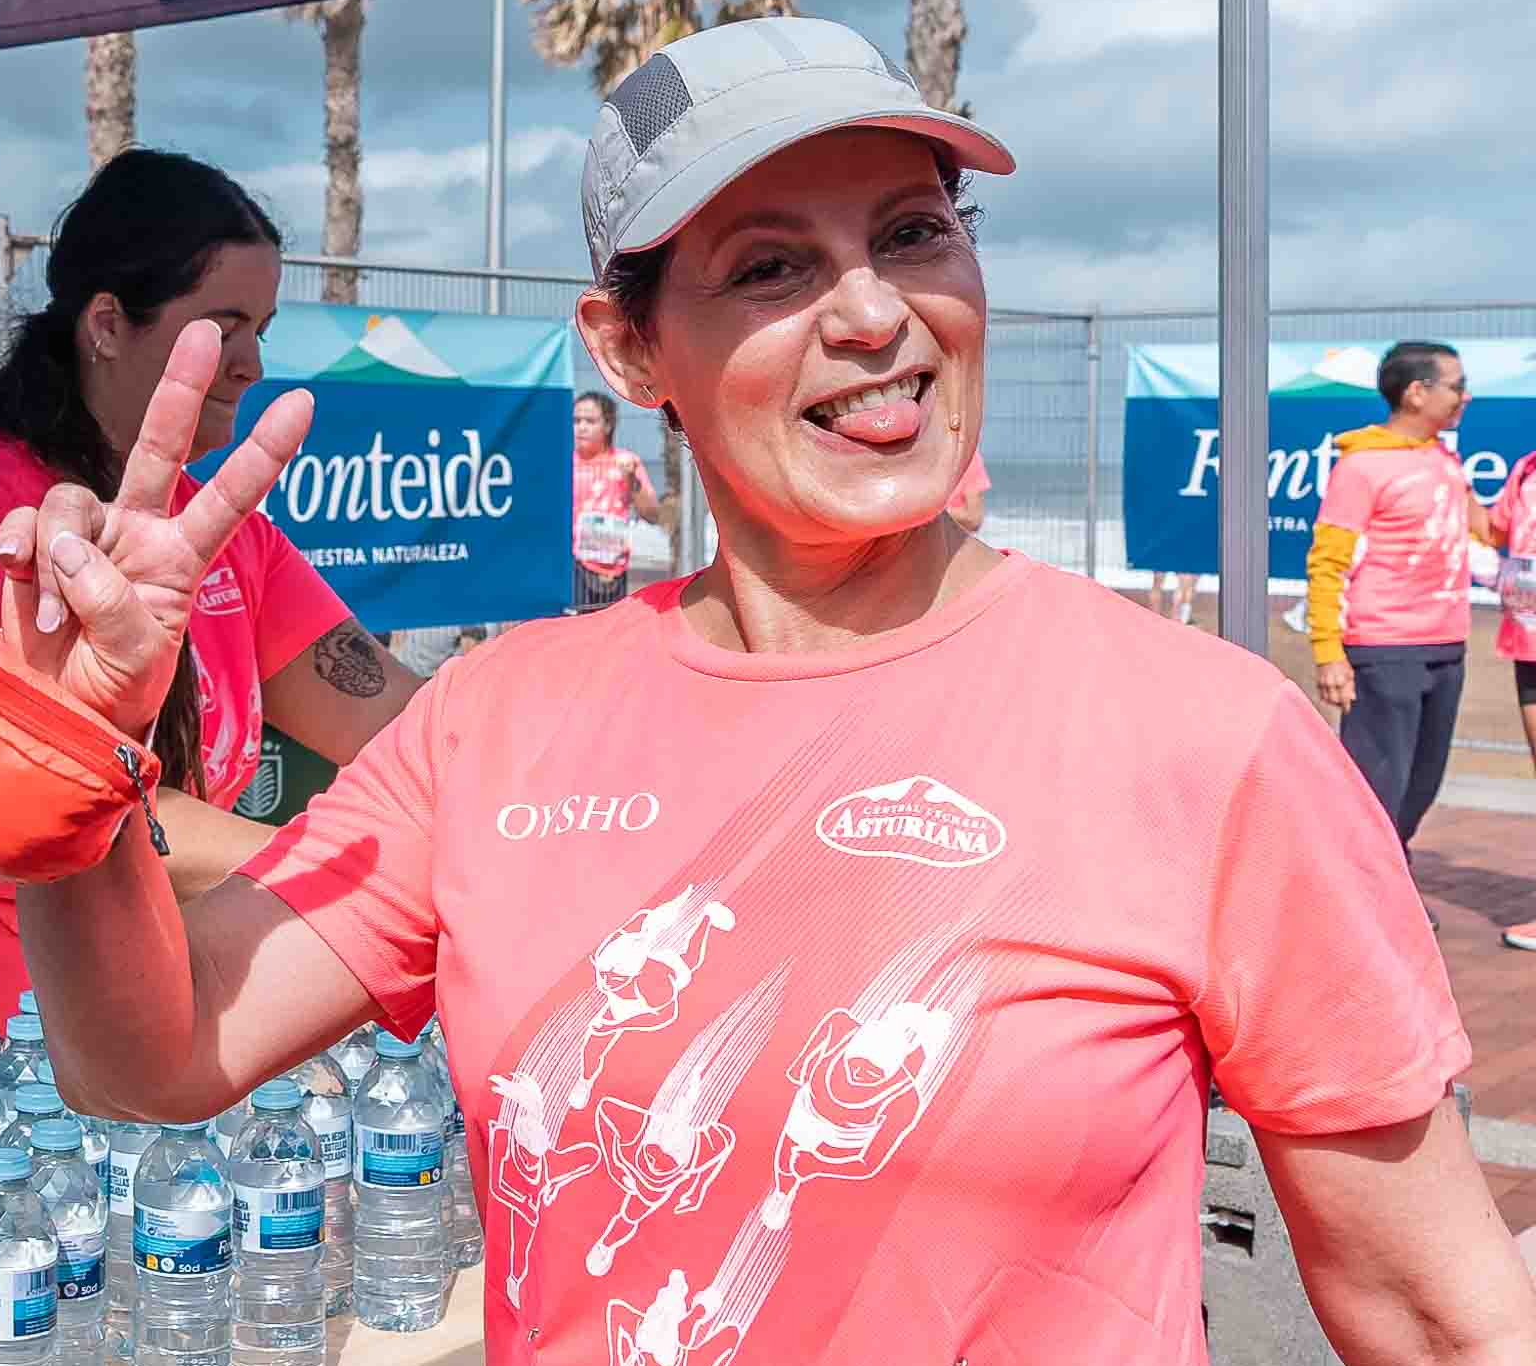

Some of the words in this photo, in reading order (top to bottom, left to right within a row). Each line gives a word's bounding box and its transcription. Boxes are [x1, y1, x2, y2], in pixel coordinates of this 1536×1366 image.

[372, 542, 470, 565] NATURALEZA
[496, 791, 660, 841] OYSHO
[827, 806, 990, 855] ASTURIANA
